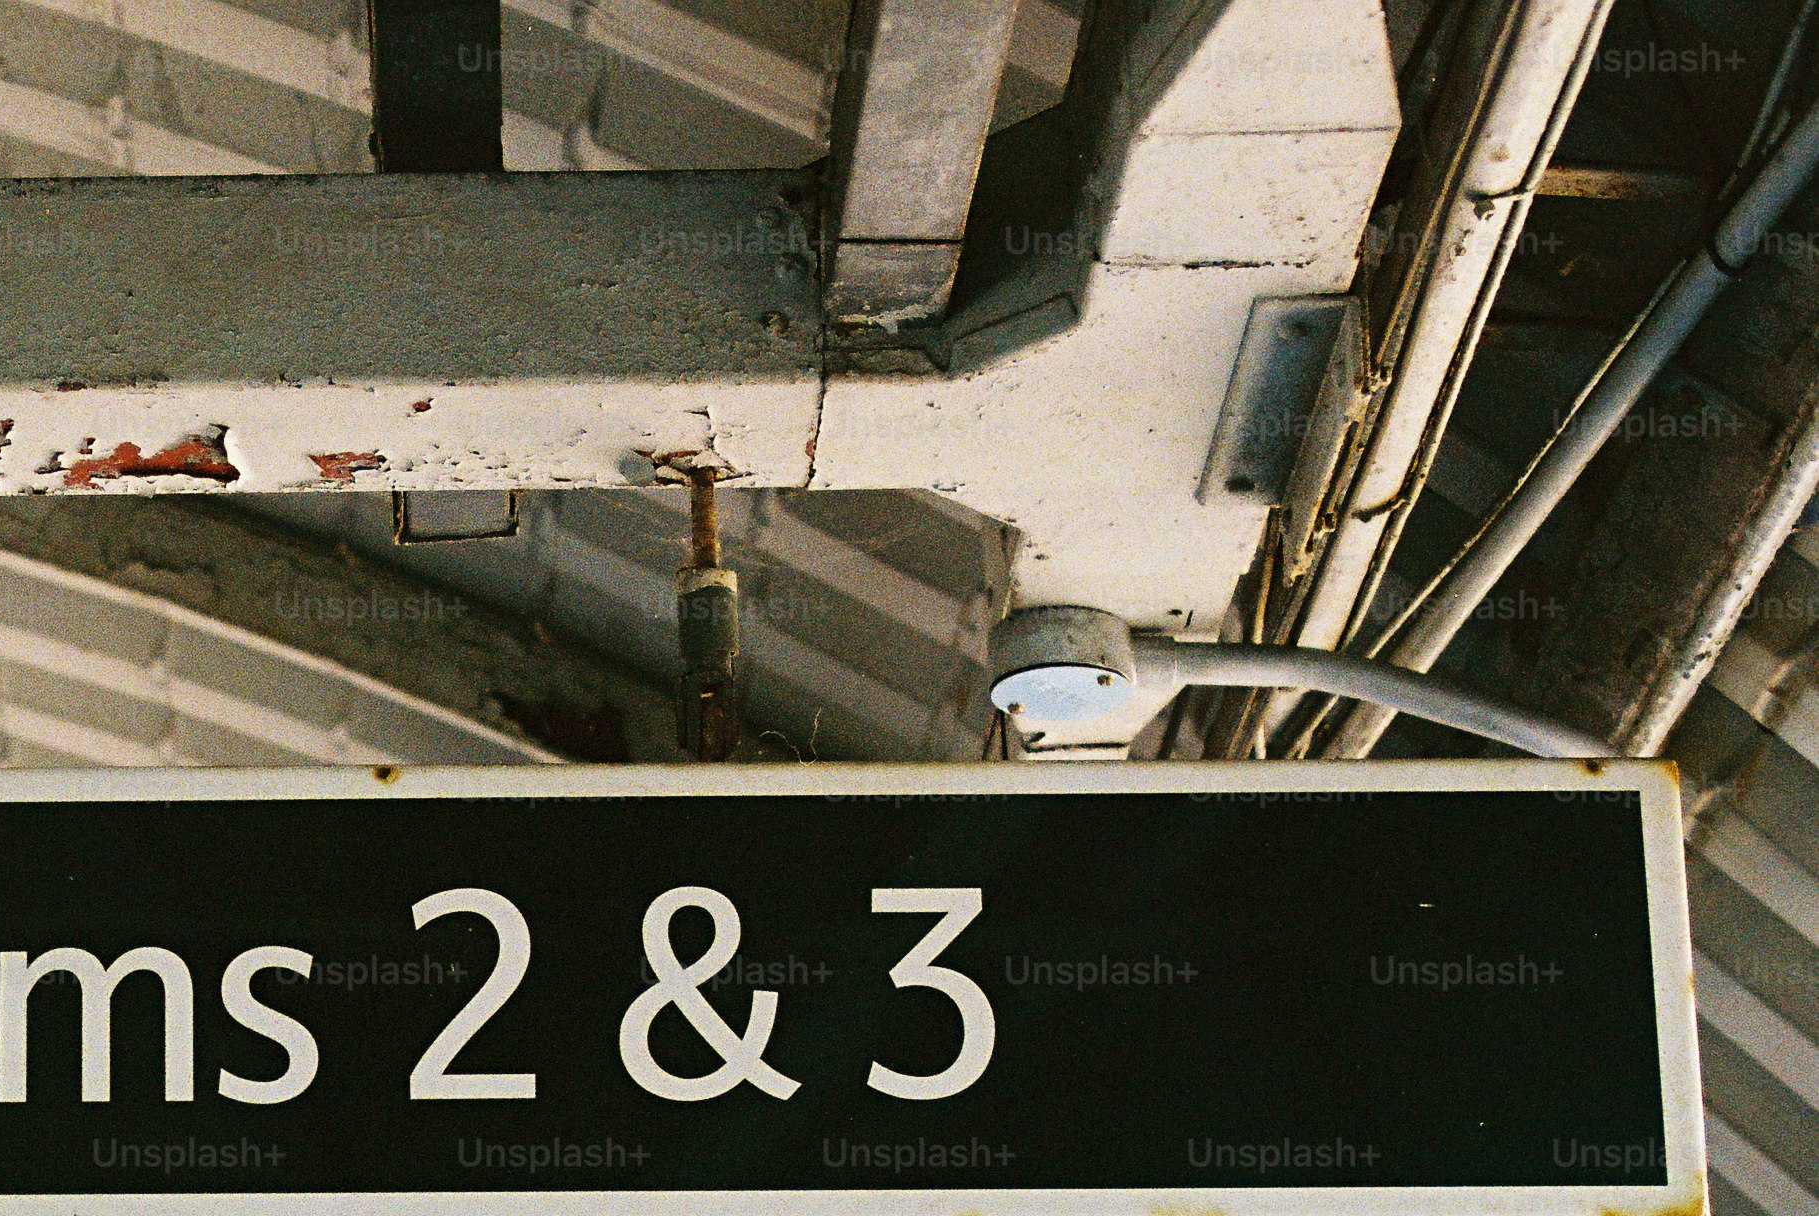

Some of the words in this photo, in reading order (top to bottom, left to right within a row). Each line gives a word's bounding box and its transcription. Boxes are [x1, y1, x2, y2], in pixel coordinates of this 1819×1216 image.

[409, 887, 537, 1101] 2
[619, 886, 802, 1102] &
[867, 887, 996, 1102] 3
